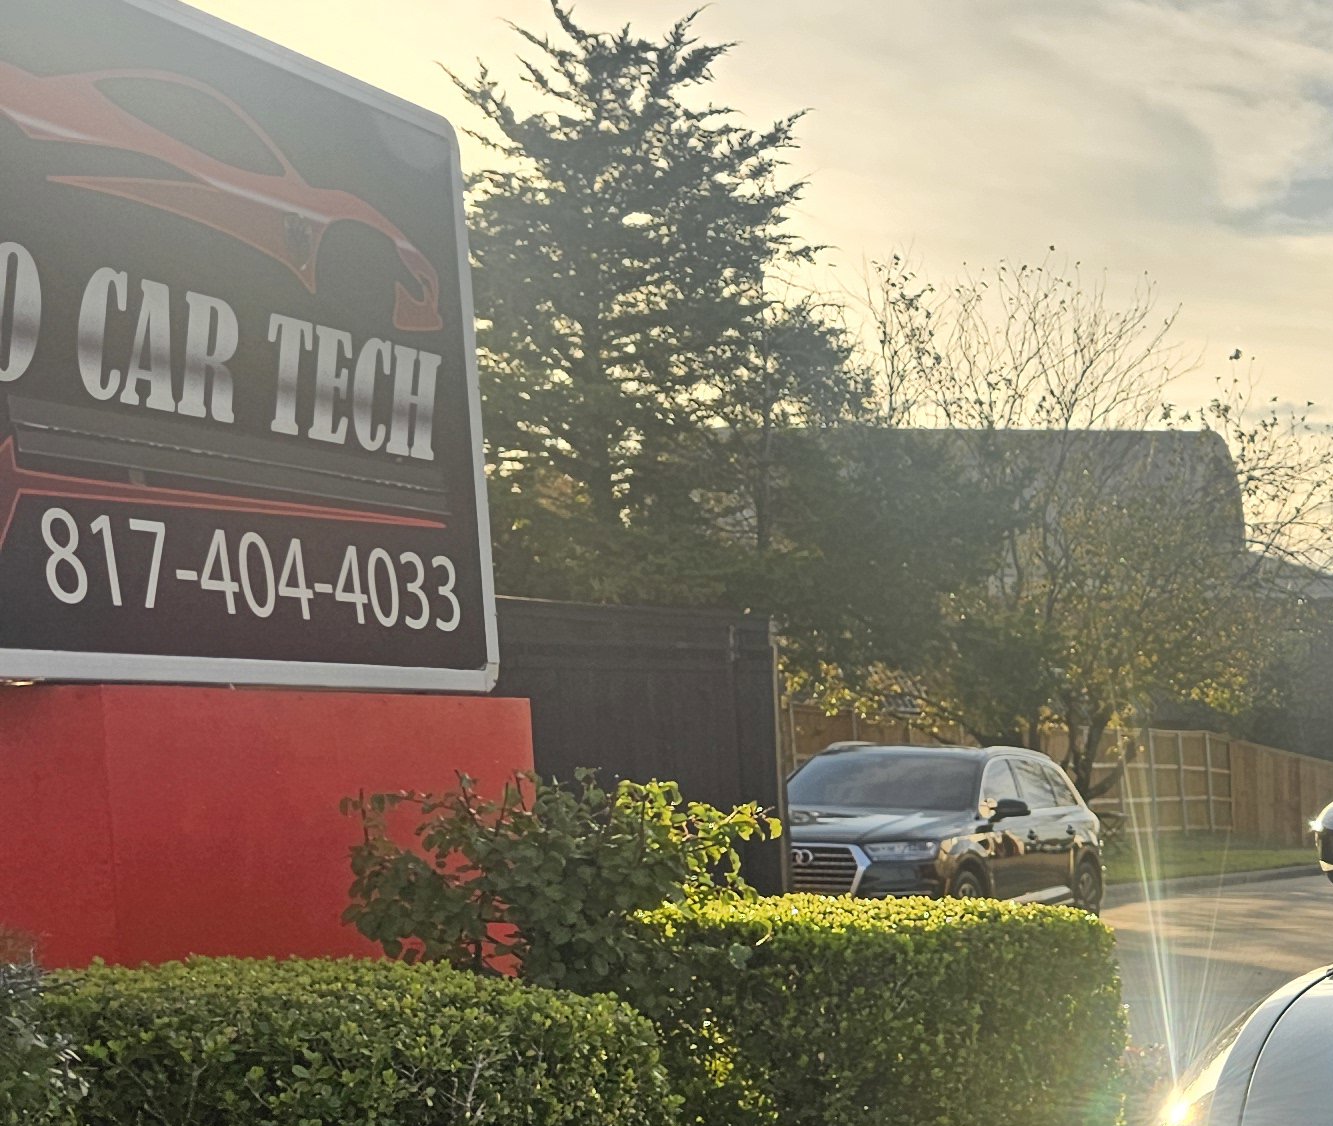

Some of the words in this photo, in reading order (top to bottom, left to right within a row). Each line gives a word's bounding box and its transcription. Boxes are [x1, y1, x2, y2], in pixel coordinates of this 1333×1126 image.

[77, 266, 240, 424] CAR
[267, 313, 442, 461] TECH
[40, 507, 461, 632] 817-404-4033
